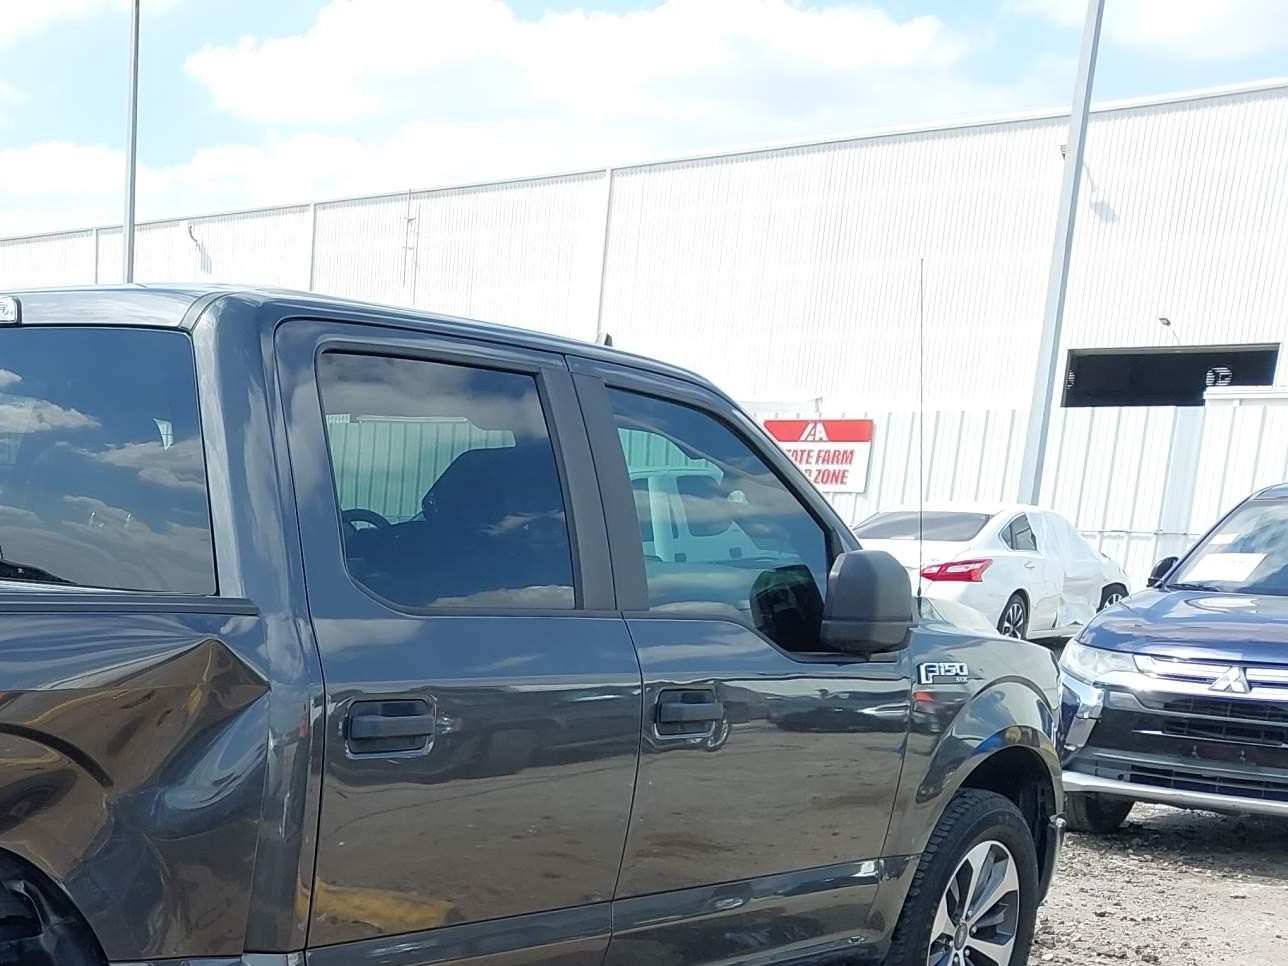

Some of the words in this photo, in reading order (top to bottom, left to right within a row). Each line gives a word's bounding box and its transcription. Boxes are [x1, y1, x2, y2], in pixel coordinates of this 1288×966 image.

[786, 449, 814, 465] ATE
[815, 449, 855, 465] FARM
[813, 469, 849, 485] ZONE
